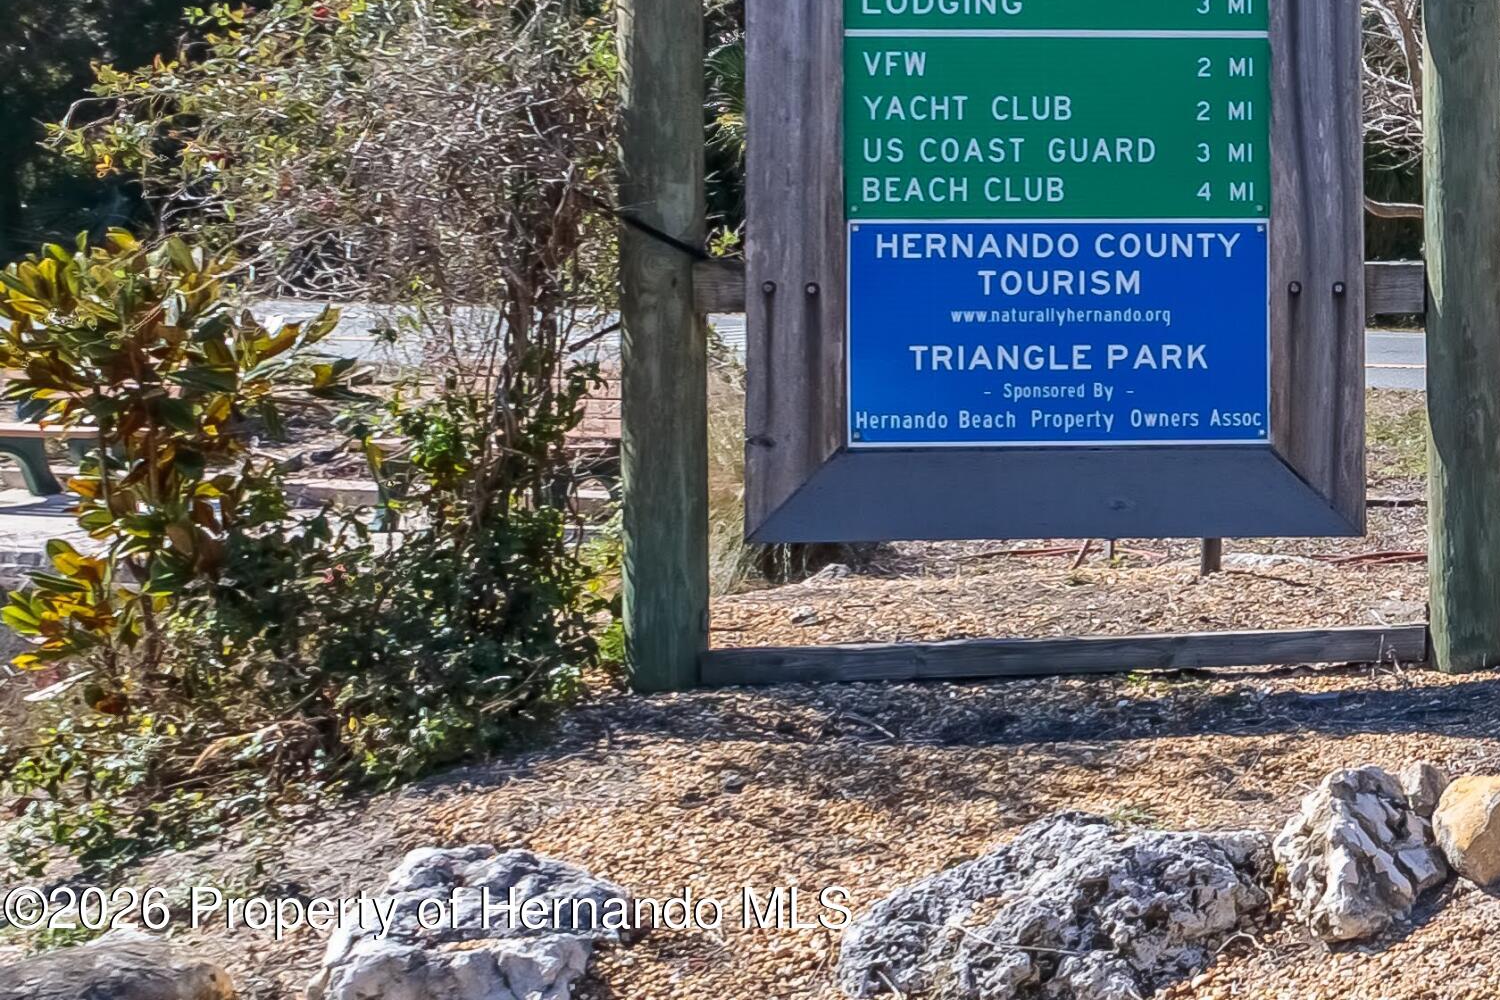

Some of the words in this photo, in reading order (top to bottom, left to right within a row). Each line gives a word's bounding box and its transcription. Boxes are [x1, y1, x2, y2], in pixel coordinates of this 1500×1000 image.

[863, 52, 925, 76] VFW
[1198, 58, 1210, 77] 2
[1230, 58, 1252, 76] MI
[864, 96, 968, 120] YACHT
[992, 96, 1071, 120] CLUB
[1197, 101, 1210, 120] 2
[1229, 102, 1251, 120] MI
[864, 138, 903, 162] US
[920, 138, 1024, 162] COAST
[1049, 138, 1155, 162] GUARD
[1197, 143, 1210, 162] 3
[1229, 143, 1252, 162] MI
[863, 178, 967, 201] BEACH
[985, 177, 1064, 201] CLUB
[1197, 182, 1211, 200] 4
[1230, 182, 1253, 201] MI
[877, 233, 1078, 258] HERNANDO
[1095, 233, 1240, 257] COUNTY
[978, 271, 1139, 295] TOURISM
[951, 308, 1170, 326] www.naturallyhernando.org
[909, 345, 1091, 370] TRIANGLE
[1108, 345, 1207, 369] PARK
[1004, 383, 1084, 402] Sponsored
[1094, 383, 1113, 401] By
[855, 411, 948, 430] Hernando
[959, 410, 1015, 428] Beach
[1032, 410, 1114, 433] Property
[1131, 409, 1198, 427] Owners
[1210, 409, 1262, 428] Assoc
